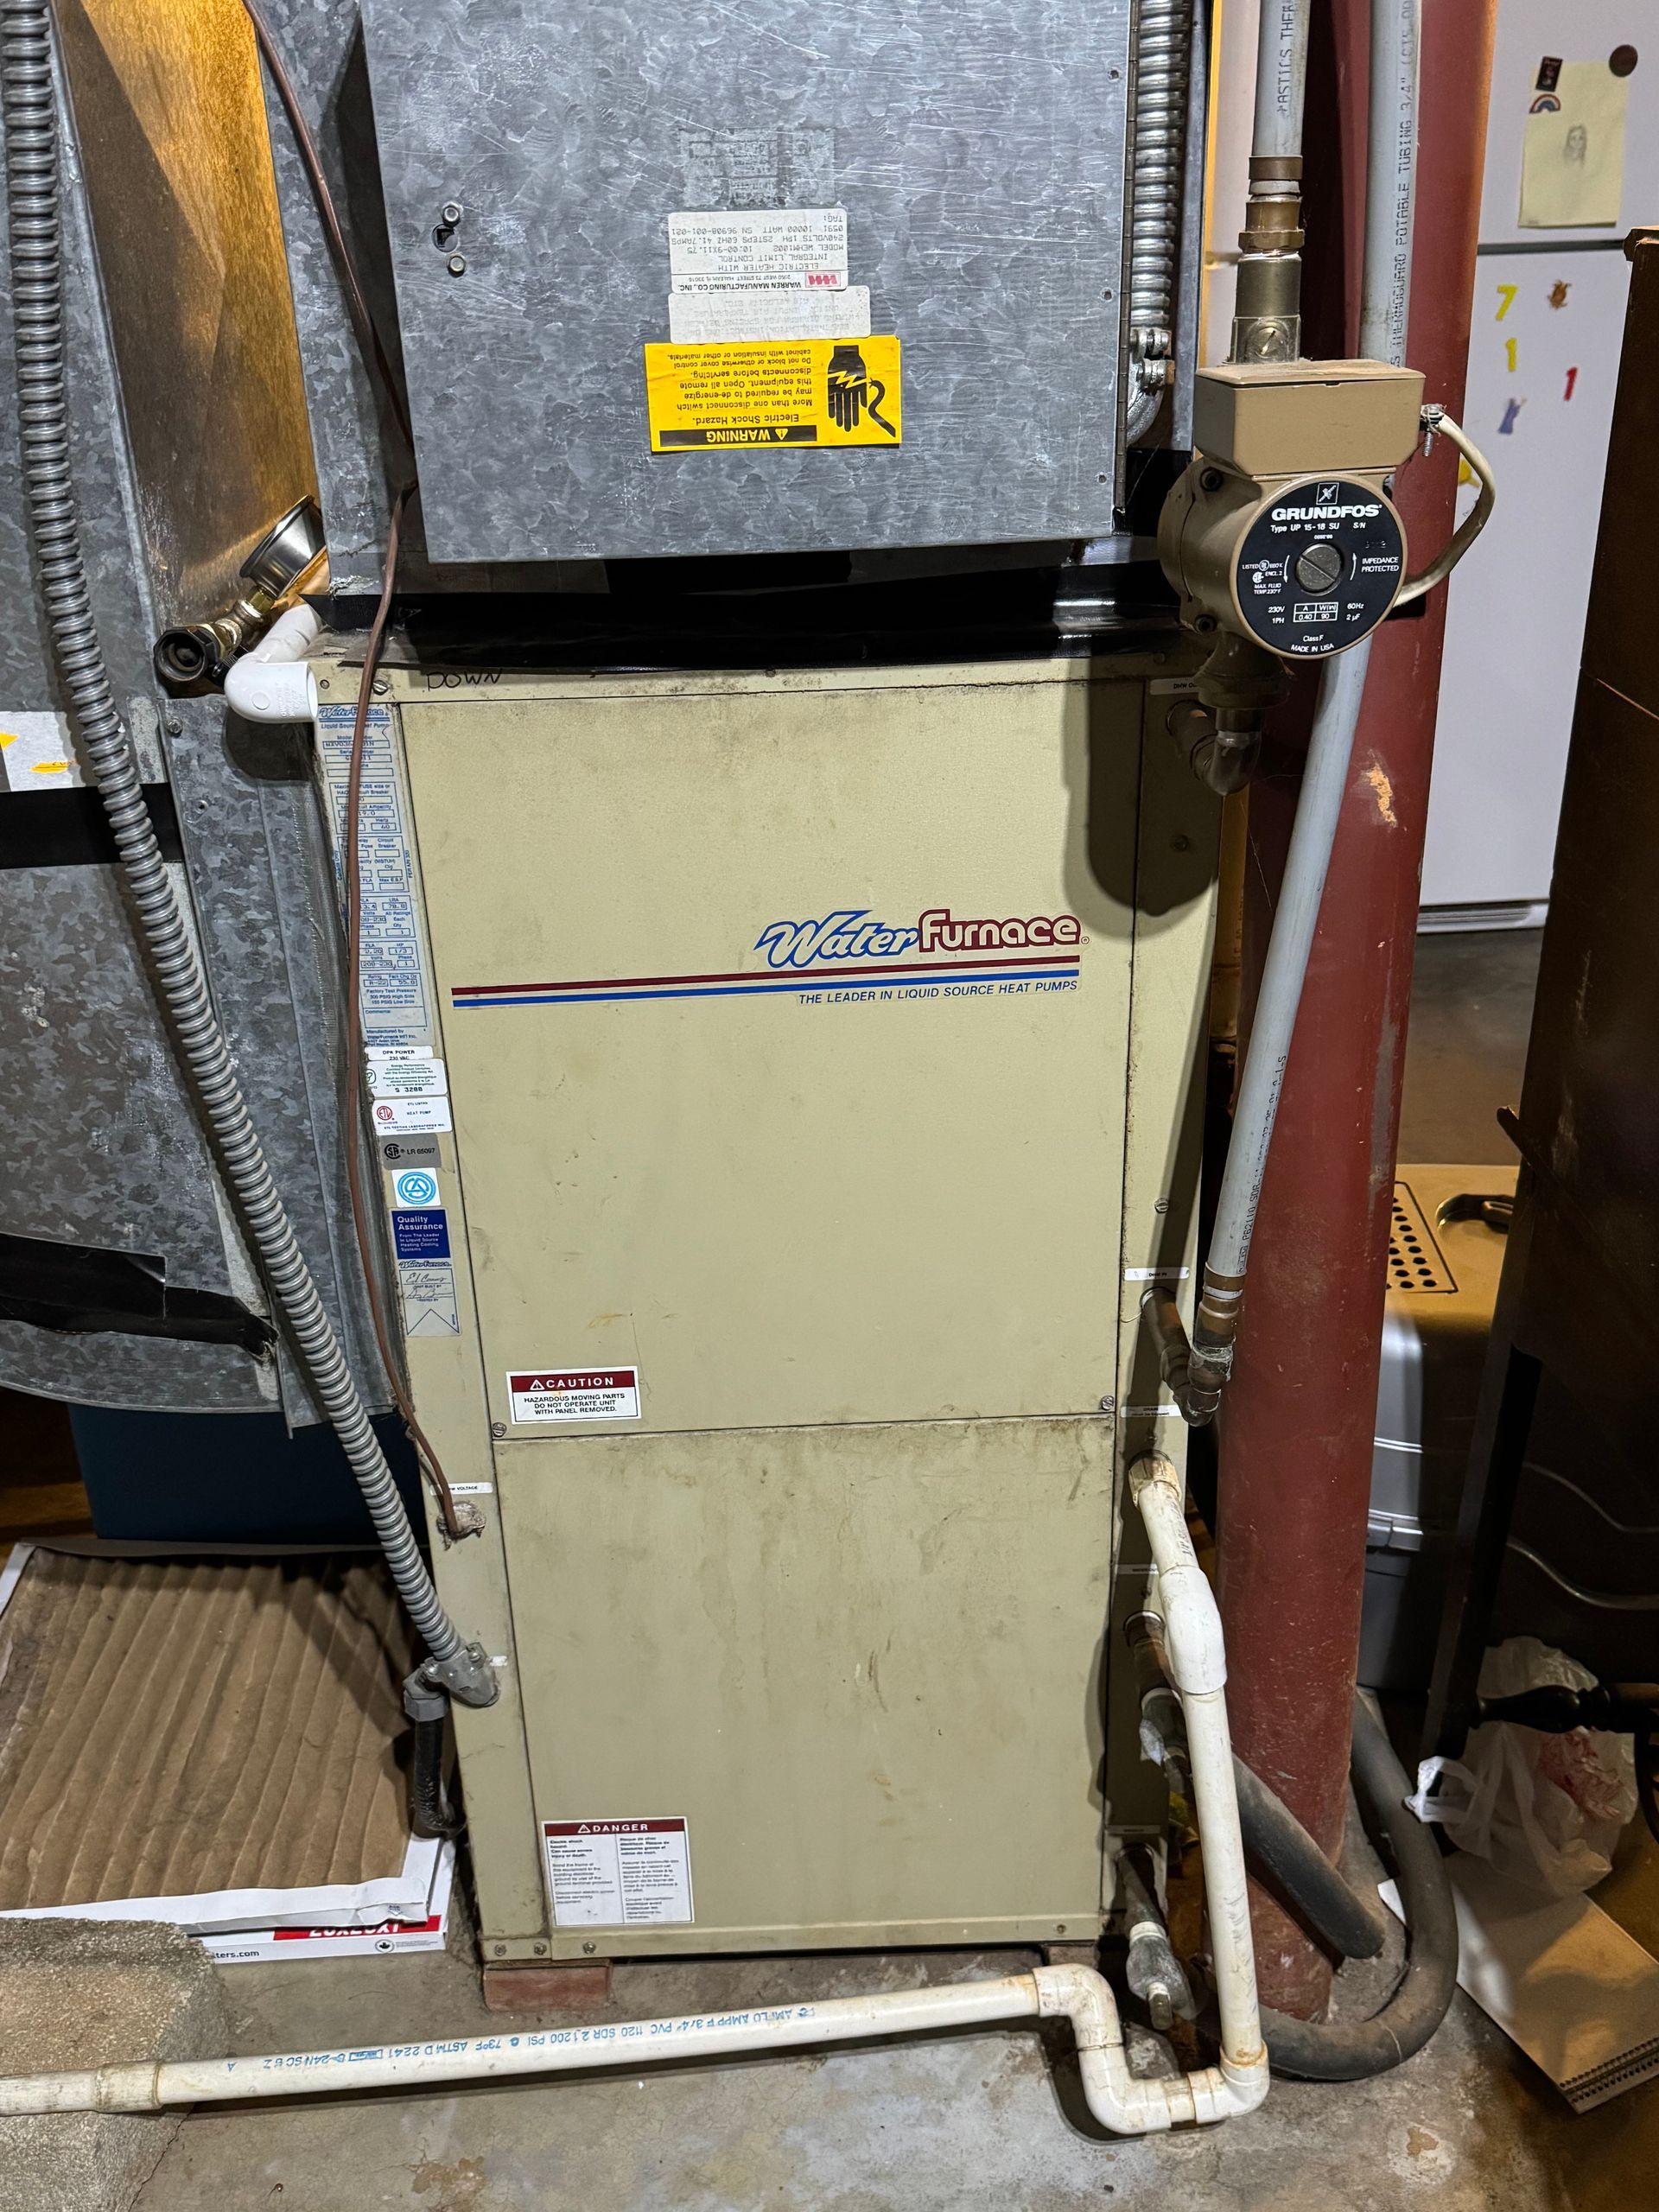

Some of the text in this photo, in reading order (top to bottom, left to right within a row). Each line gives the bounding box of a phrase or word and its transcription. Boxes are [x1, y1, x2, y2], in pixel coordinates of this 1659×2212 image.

[1398, 121, 1412, 174] TUBING
[1395, 183, 1409, 245] POTABLE
[1496, 284, 1517, 321] 7
[690, 369, 729, 379] servicing.
[763, 368, 811, 377] disconnects
[725, 379, 745, 388] Open
[748, 377, 793, 388] equipment.
[684, 389, 731, 401] de-energize
[746, 389, 779, 397] required
[796, 387, 811, 396] may
[707, 402, 750, 410] disconnect
[693, 414, 798, 425] Electric Shock Hazard.
[706, 429, 770, 442] WARNING
[1272, 505, 1380, 522] GRUNDFOS
[1270, 524, 1287, 533] Type
[1291, 644, 1309, 652] MADE
[427, 669, 502, 691] DOWN
[754, 908, 1081, 969] WaterFurnace
[798, 980, 1077, 1005] THE LEADER IN LIQUID SOURCE HEAT PUMPS
[546, 1377, 613, 1389] CAUTION
[594, 2028, 615, 2038] SDR
[621, 2025, 642, 2036] 1120
[650, 2023, 671, 2033] PVC
[528, 2035, 544, 2045] PSI
[389, 2046, 420, 2058] 2241
[436, 2041, 467, 2055] ASTM
